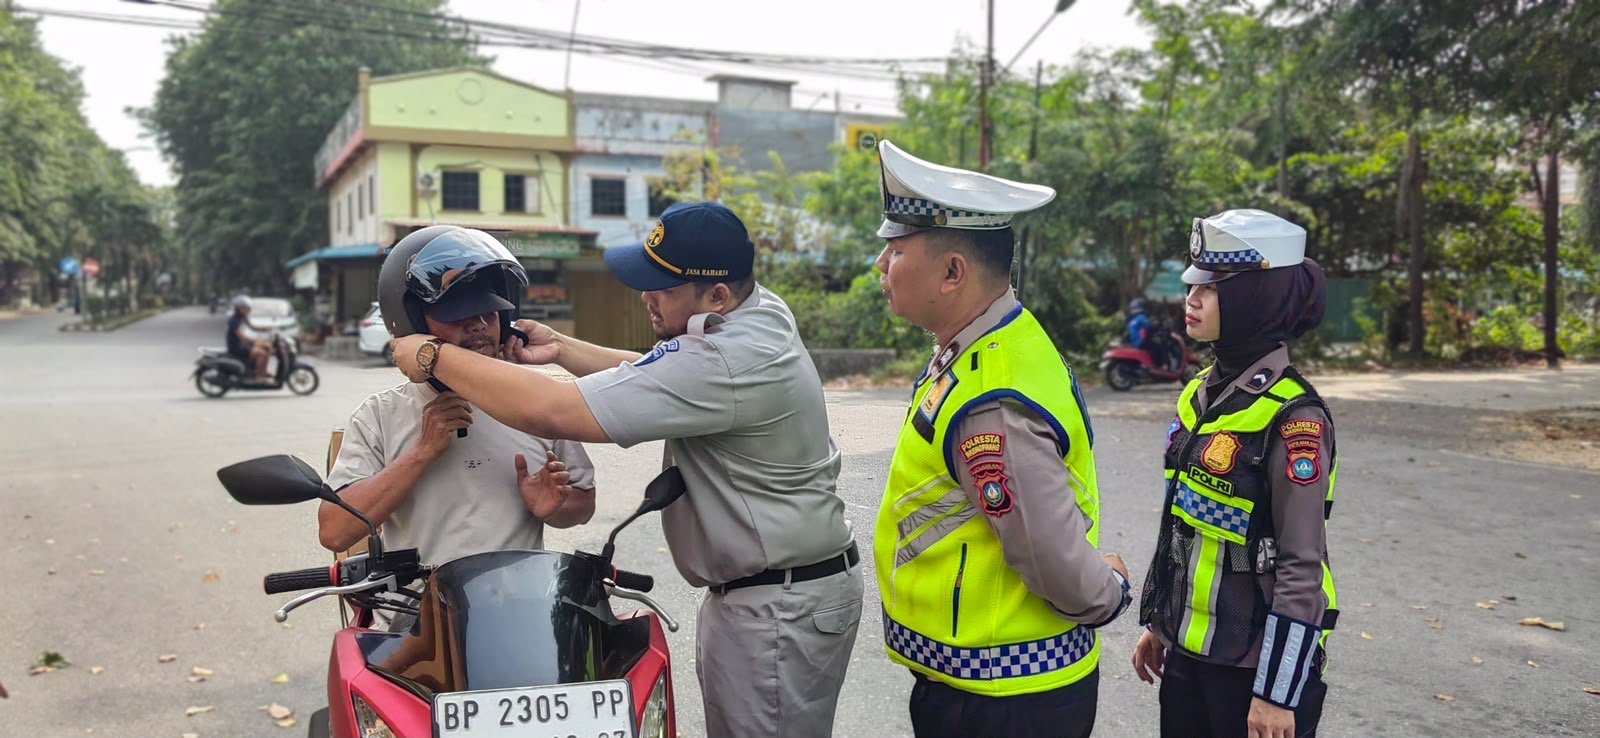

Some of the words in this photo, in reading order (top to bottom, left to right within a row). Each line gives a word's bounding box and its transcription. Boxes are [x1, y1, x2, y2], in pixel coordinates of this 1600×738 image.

[685, 268, 700, 276] JASA
[701, 268, 729, 276] RAHARJA
[1281, 421, 1320, 432] POLRESTA
[961, 434, 1000, 452] POLRESTA
[1192, 469, 1230, 492] POLRI
[444, 700, 479, 730] BP
[499, 693, 569, 726] 2305
[592, 689, 624, 719] PP
